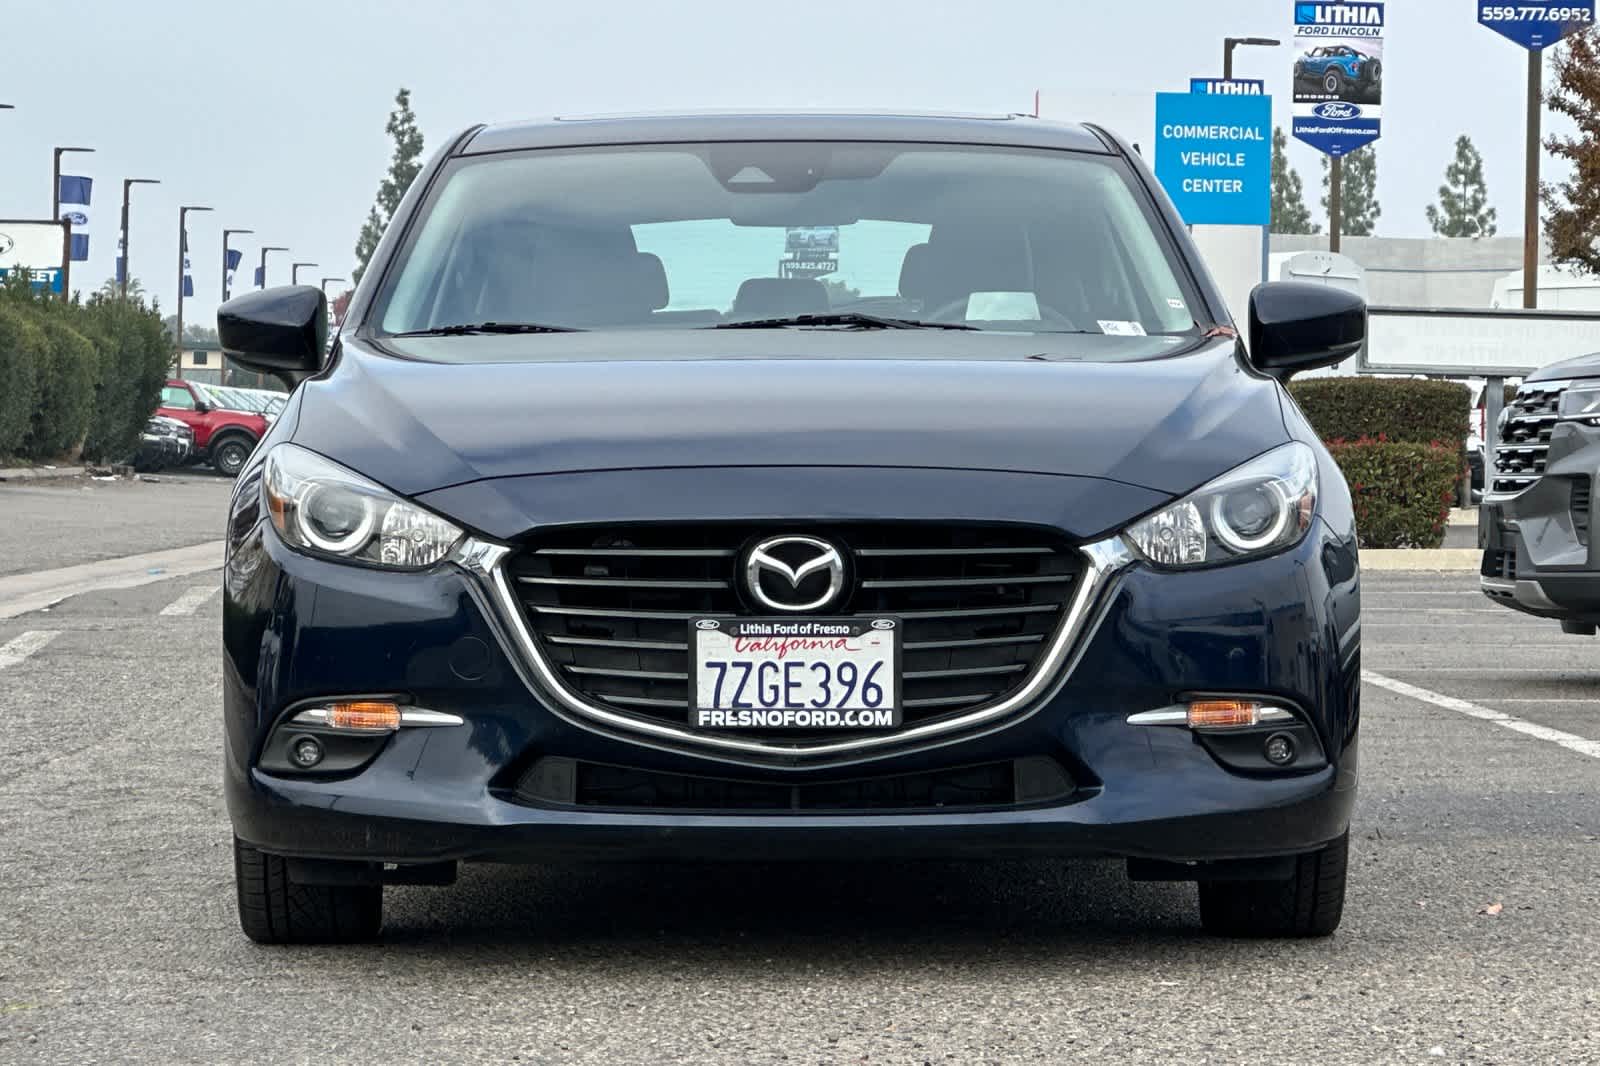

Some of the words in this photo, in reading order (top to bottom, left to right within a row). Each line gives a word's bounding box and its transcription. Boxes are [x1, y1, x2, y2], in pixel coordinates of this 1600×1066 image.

[1315, 5, 1381, 24] LITHIA
[1482, 7, 1591, 21] 559.777.6952
[1297, 26, 1329, 35] FORD
[1331, 27, 1381, 36] LINCOLN
[1207, 81, 1261, 95] LITHIA
[1321, 103, 1353, 118] Ford
[1163, 125, 1265, 141] COMMERCIAL
[1181, 152, 1246, 167] VEHICLE
[1182, 178, 1243, 193] CENTER
[740, 623, 772, 634] Lithia
[774, 623, 798, 634] Ford
[799, 623, 813, 634] of
[815, 624, 850, 634] Fresno
[734, 637, 863, 660] California
[705, 661, 884, 709] 7ZGE396
[698, 710, 893, 726] FRESNOFORD.COM
